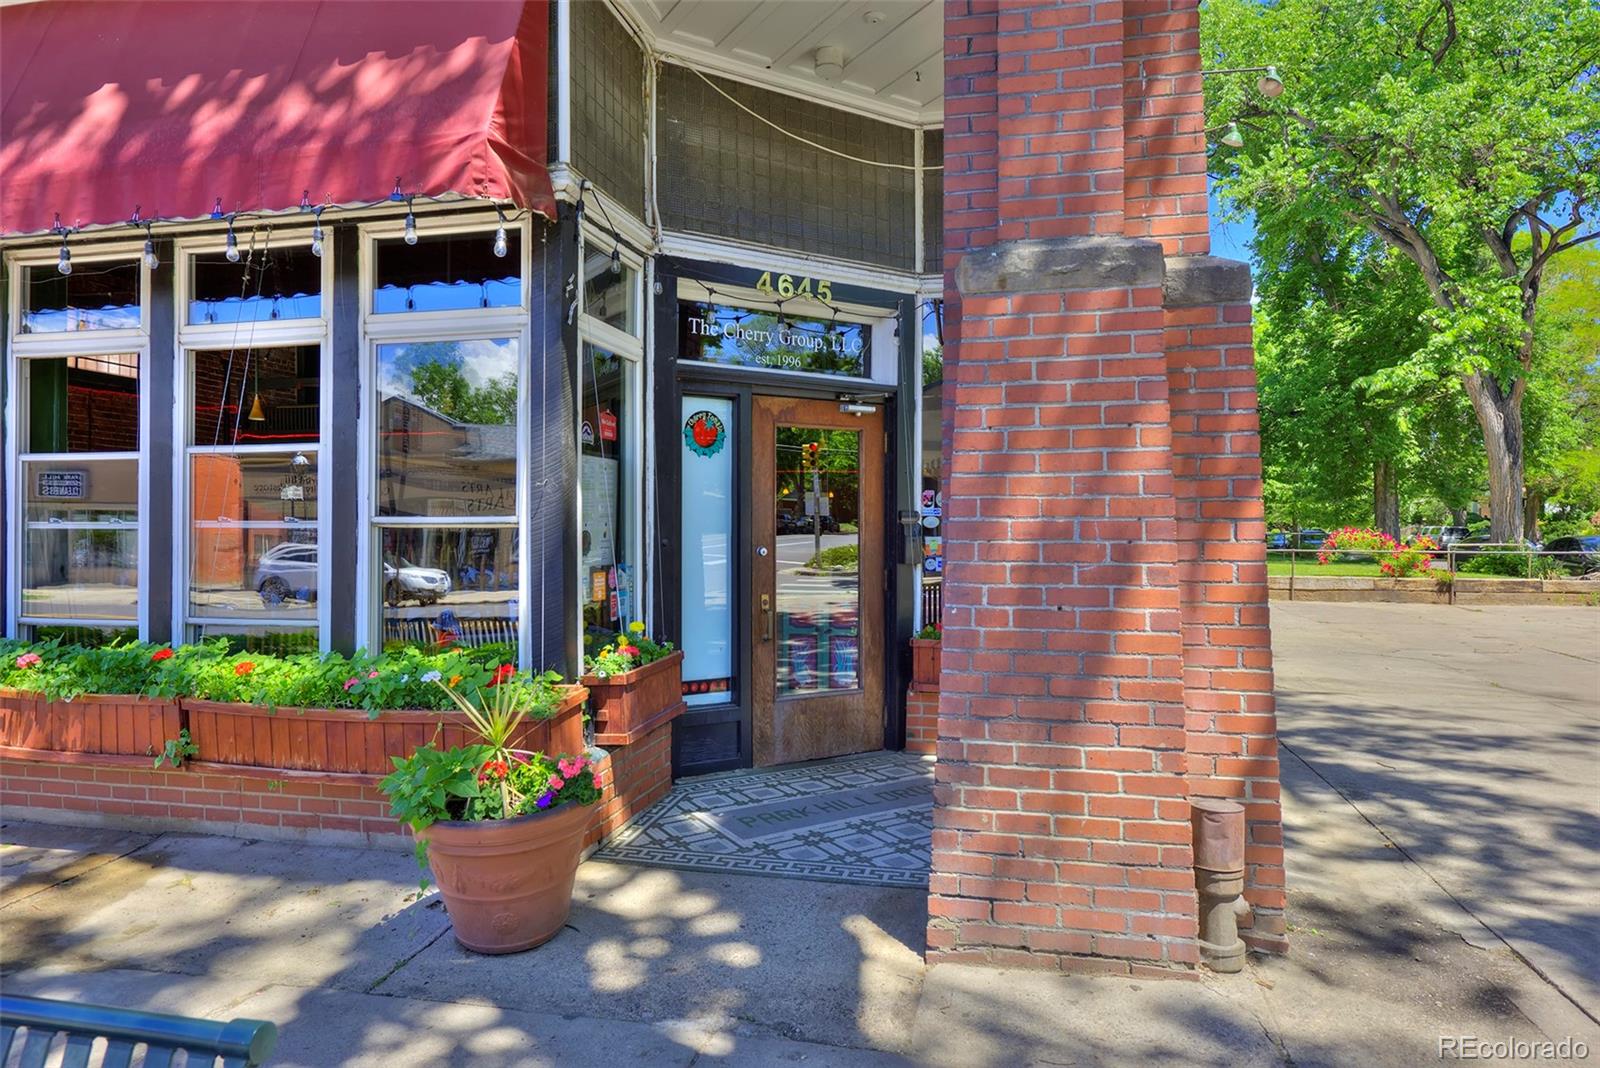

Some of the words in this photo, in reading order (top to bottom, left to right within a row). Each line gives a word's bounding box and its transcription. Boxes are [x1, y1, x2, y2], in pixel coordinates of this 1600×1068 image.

[756, 271, 833, 302] 4645
[688, 317, 719, 336] The
[723, 321, 774, 347] Cherry
[779, 329, 827, 353] Group,
[777, 354, 802, 368] 1996
[737, 804, 813, 829] PARK
[814, 796, 876, 814] HILL
